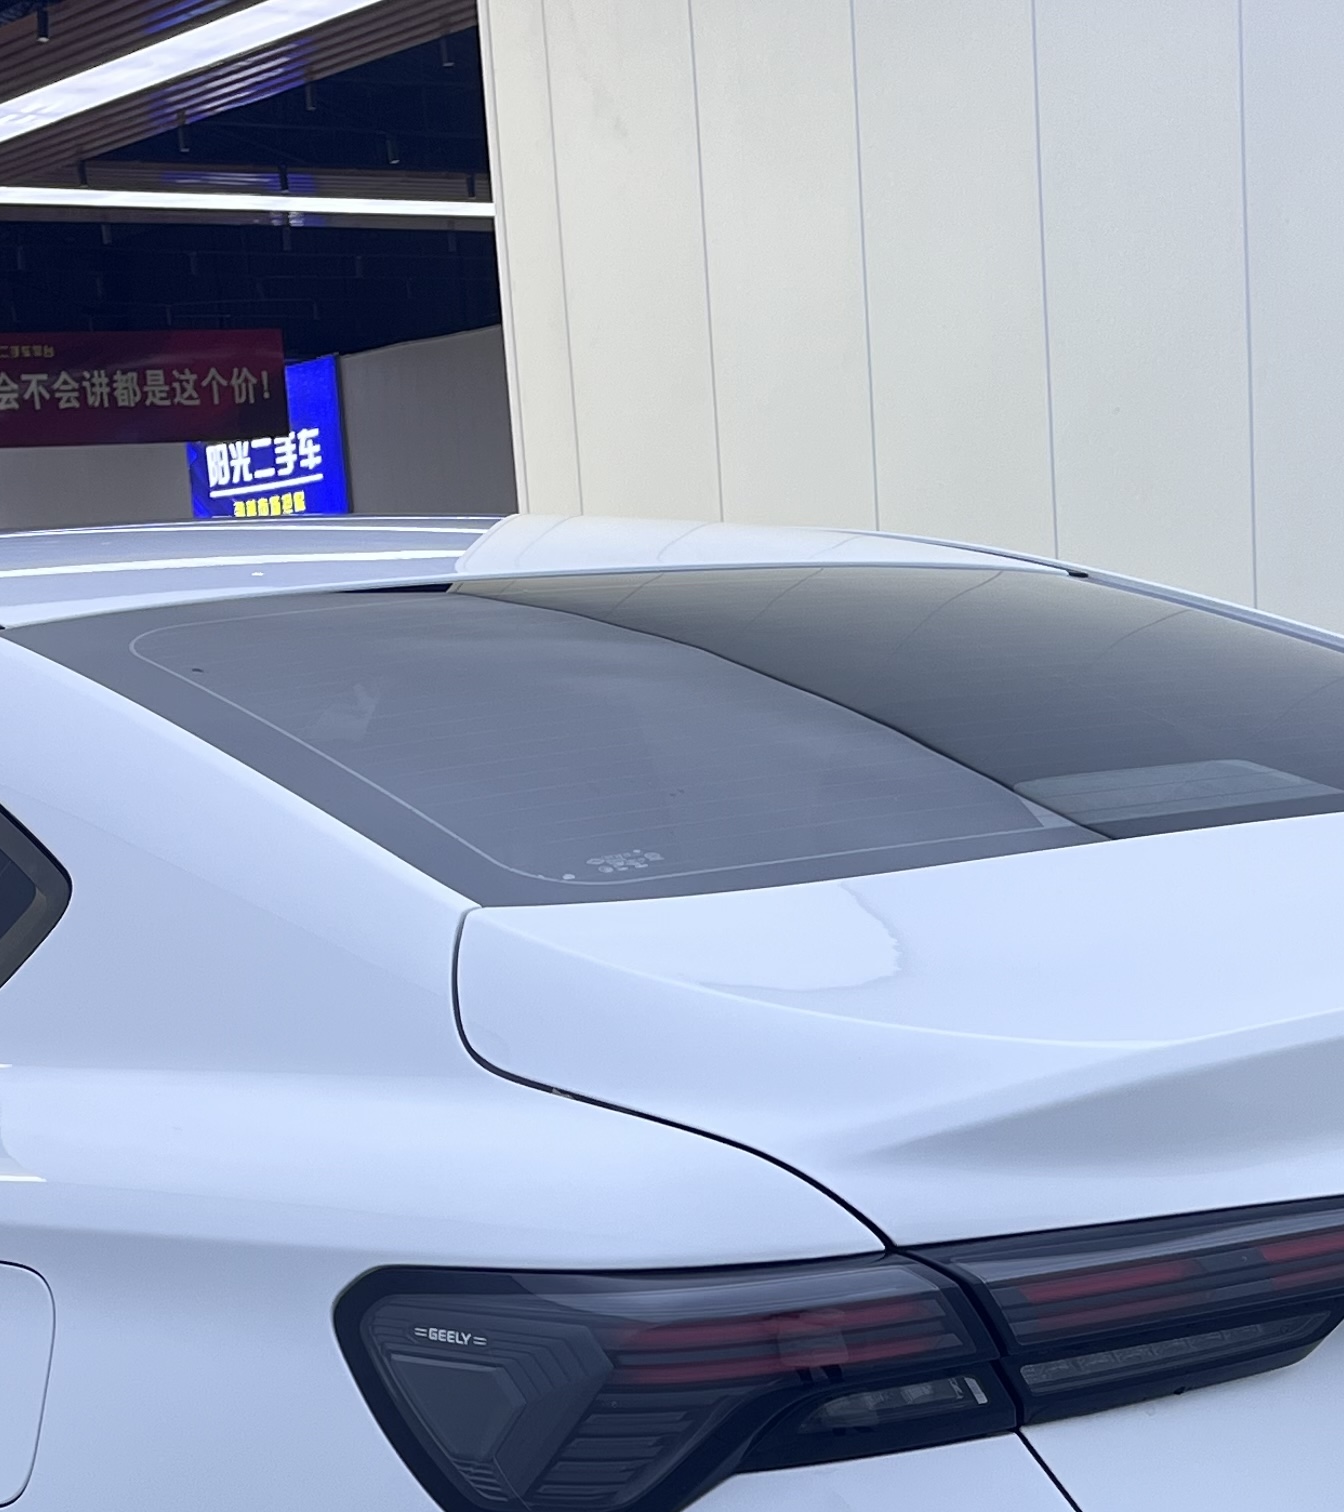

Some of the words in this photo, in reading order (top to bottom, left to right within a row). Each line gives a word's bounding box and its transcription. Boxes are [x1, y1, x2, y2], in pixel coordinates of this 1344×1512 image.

[205, 427, 323, 488] 阳光二手车
[428, 1327, 472, 1346] GEELY
